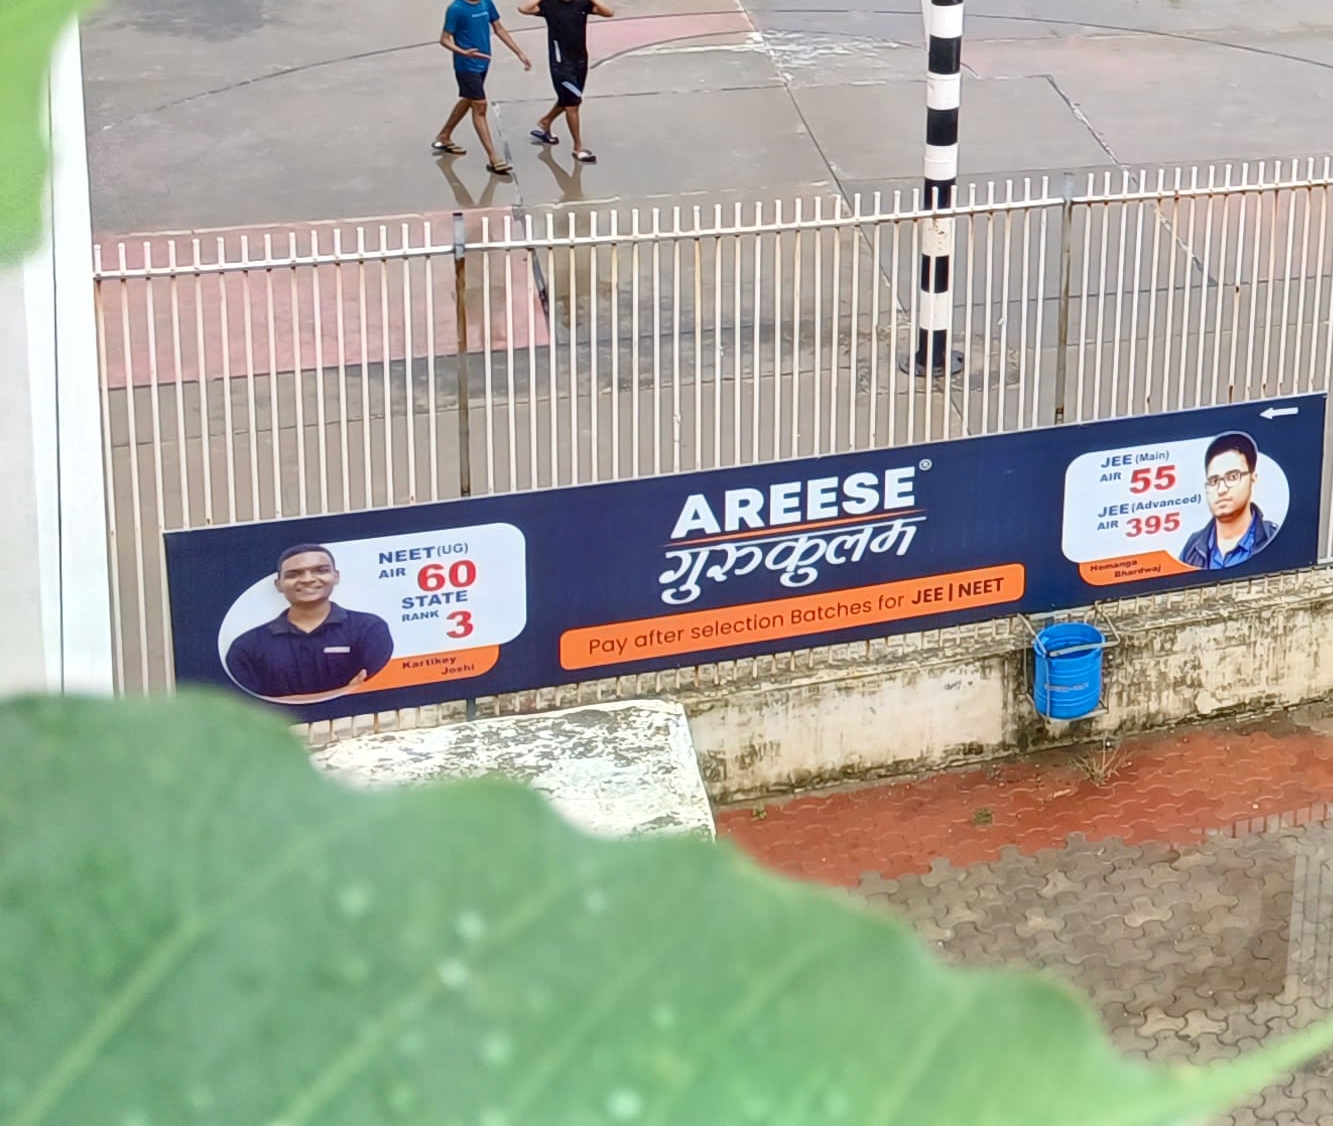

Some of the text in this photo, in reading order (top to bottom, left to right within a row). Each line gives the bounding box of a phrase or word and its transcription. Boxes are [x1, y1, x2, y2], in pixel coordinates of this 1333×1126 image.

[1101, 450, 1170, 468] JEE (Main)
[1100, 472, 1122, 483] AIR
[1129, 465, 1176, 494] 55
[671, 466, 916, 540] AREESE
[1097, 504, 1129, 518] JEE
[1097, 520, 1119, 531] AIR
[1125, 512, 1180, 538] 395
[378, 567, 406, 580] AIR
[417, 559, 477, 592] 60
[401, 590, 469, 610] STATE
[402, 610, 439, 622] RANK
[446, 610, 474, 639] 3
[589, 638, 628, 655] Pay
[634, 628, 685, 648] after
[690, 614, 784, 640] selection
[790, 601, 872, 625] Batches
[878, 594, 905, 611] for
[402, 657, 457, 670] Kartikey
[441, 663, 475, 676] Joshi
